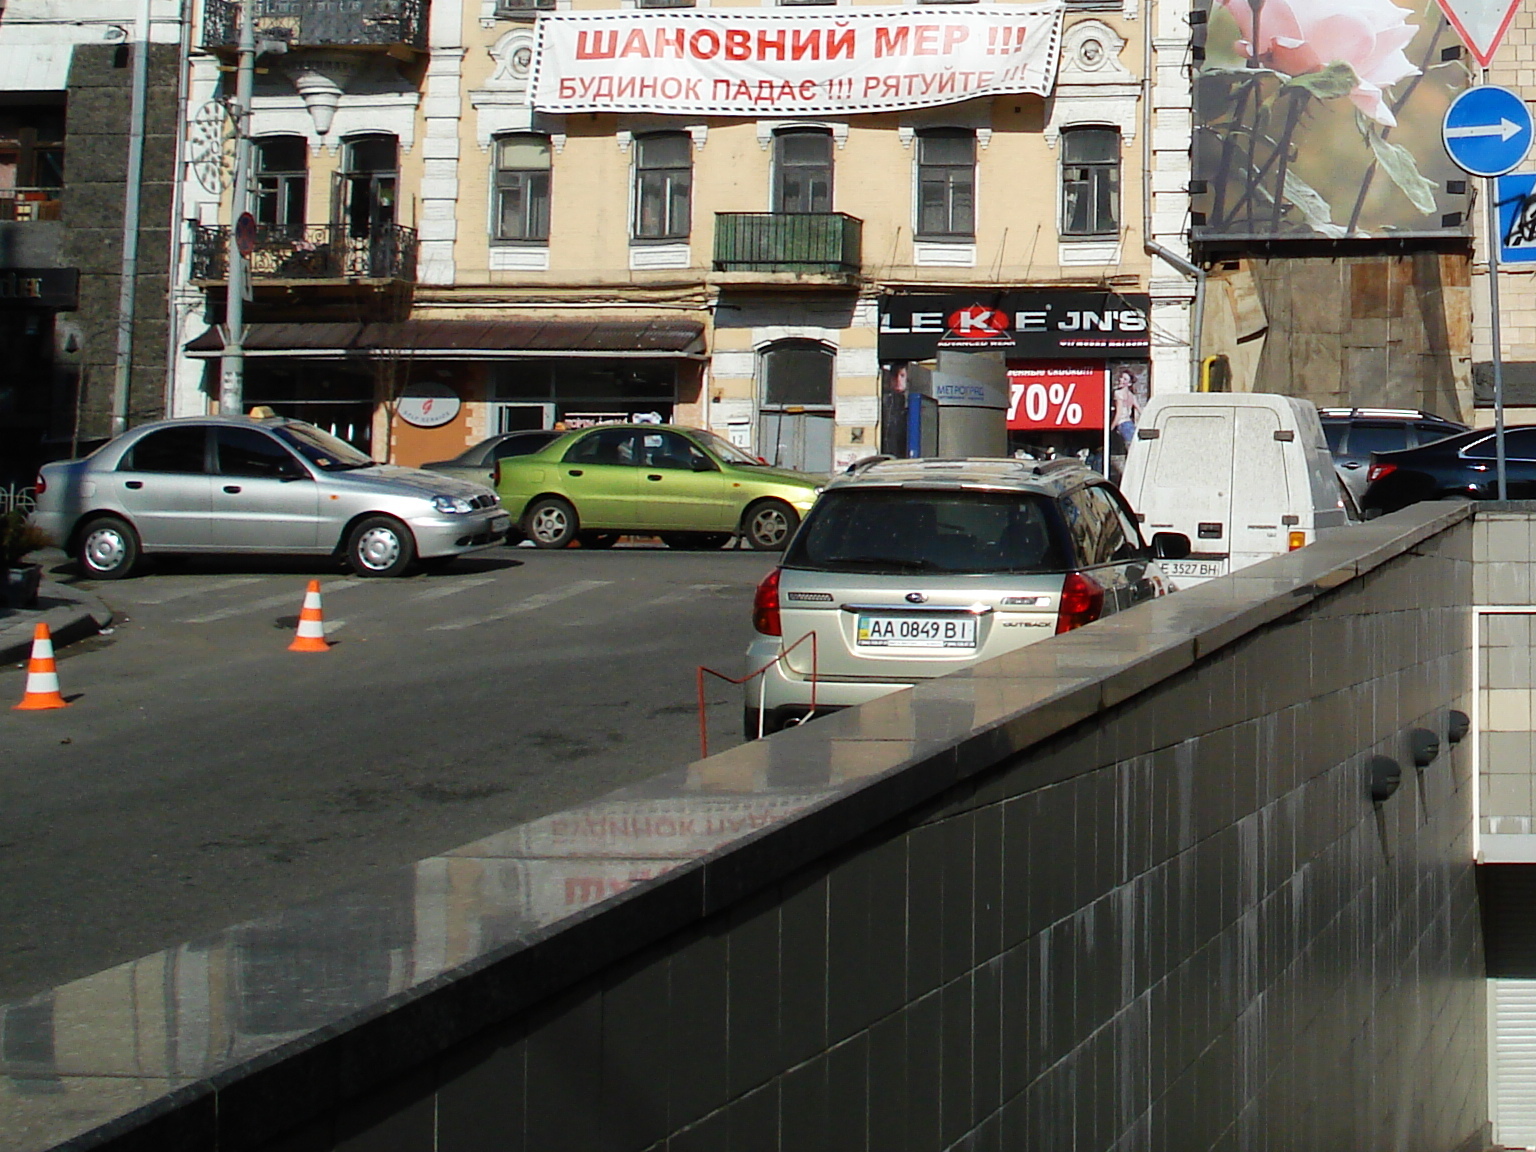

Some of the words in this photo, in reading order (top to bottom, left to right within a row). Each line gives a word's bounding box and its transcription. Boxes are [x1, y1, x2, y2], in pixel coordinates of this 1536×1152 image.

[574, 22, 856, 62] ШАНОВНИЙ
[873, 24, 971, 56] МЕР
[986, 25, 1026, 55] !!!
[557, 74, 702, 102] БУДИНОК
[711, 79, 819, 105] ПАДАЄ
[826, 77, 852, 100] !!!
[863, 65, 995, 98] РЯТУЙТЕ
[1057, 310, 1147, 332] JN'S
[1172, 563, 1198, 575] 3527
[870, 622, 895, 638] AA
[900, 622, 939, 638] 0849
[945, 622, 966, 638] BI
